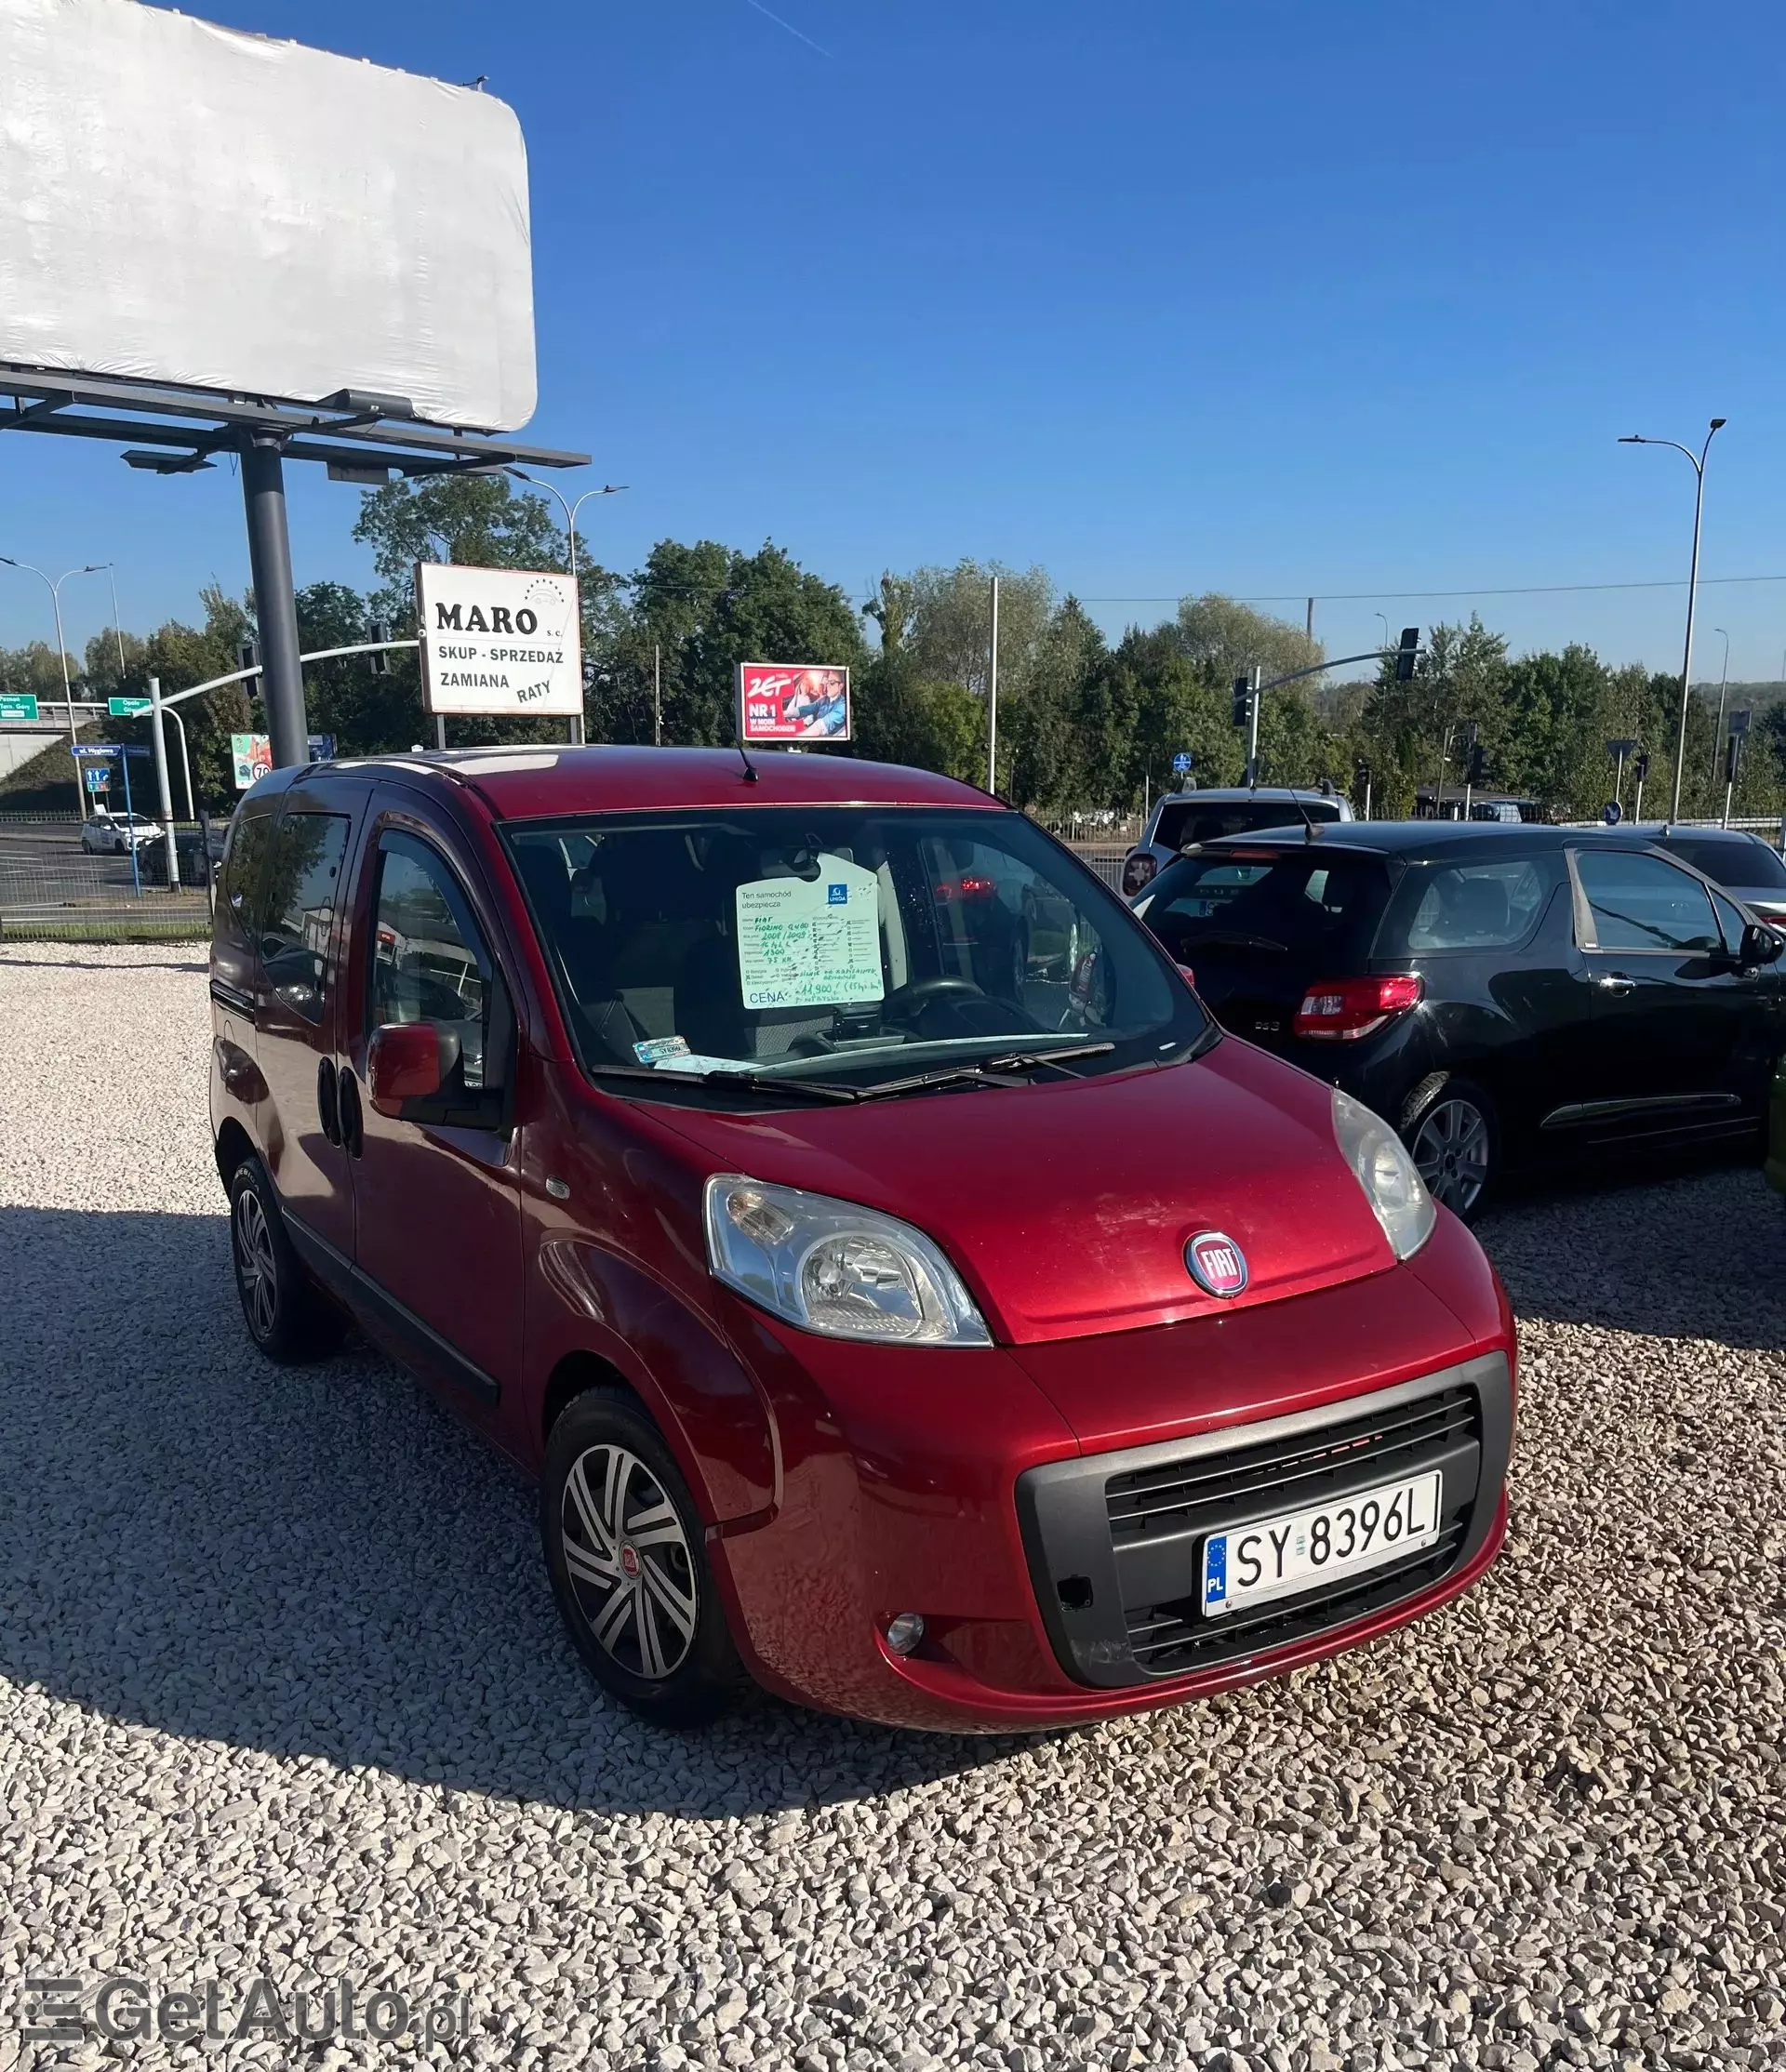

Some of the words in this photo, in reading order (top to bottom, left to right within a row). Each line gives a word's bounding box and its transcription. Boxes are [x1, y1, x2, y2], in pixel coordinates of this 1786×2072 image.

[435, 603, 538, 634] MARO
[439, 646, 477, 660] SKUP
[490, 648, 564, 664] SPRZEDAŻ
[440, 672, 510, 688] ZAMIANA
[747, 676, 792, 697] ZET
[516, 680, 551, 703] RATY
[256, 768, 270, 778] 70
[757, 890, 791, 899] samochód
[1200, 1248, 1238, 1279] FIAT
[1237, 1524, 1292, 1587] SY
[1310, 1488, 1425, 1565] 8396L
[1207, 1577, 1223, 1593] PL
